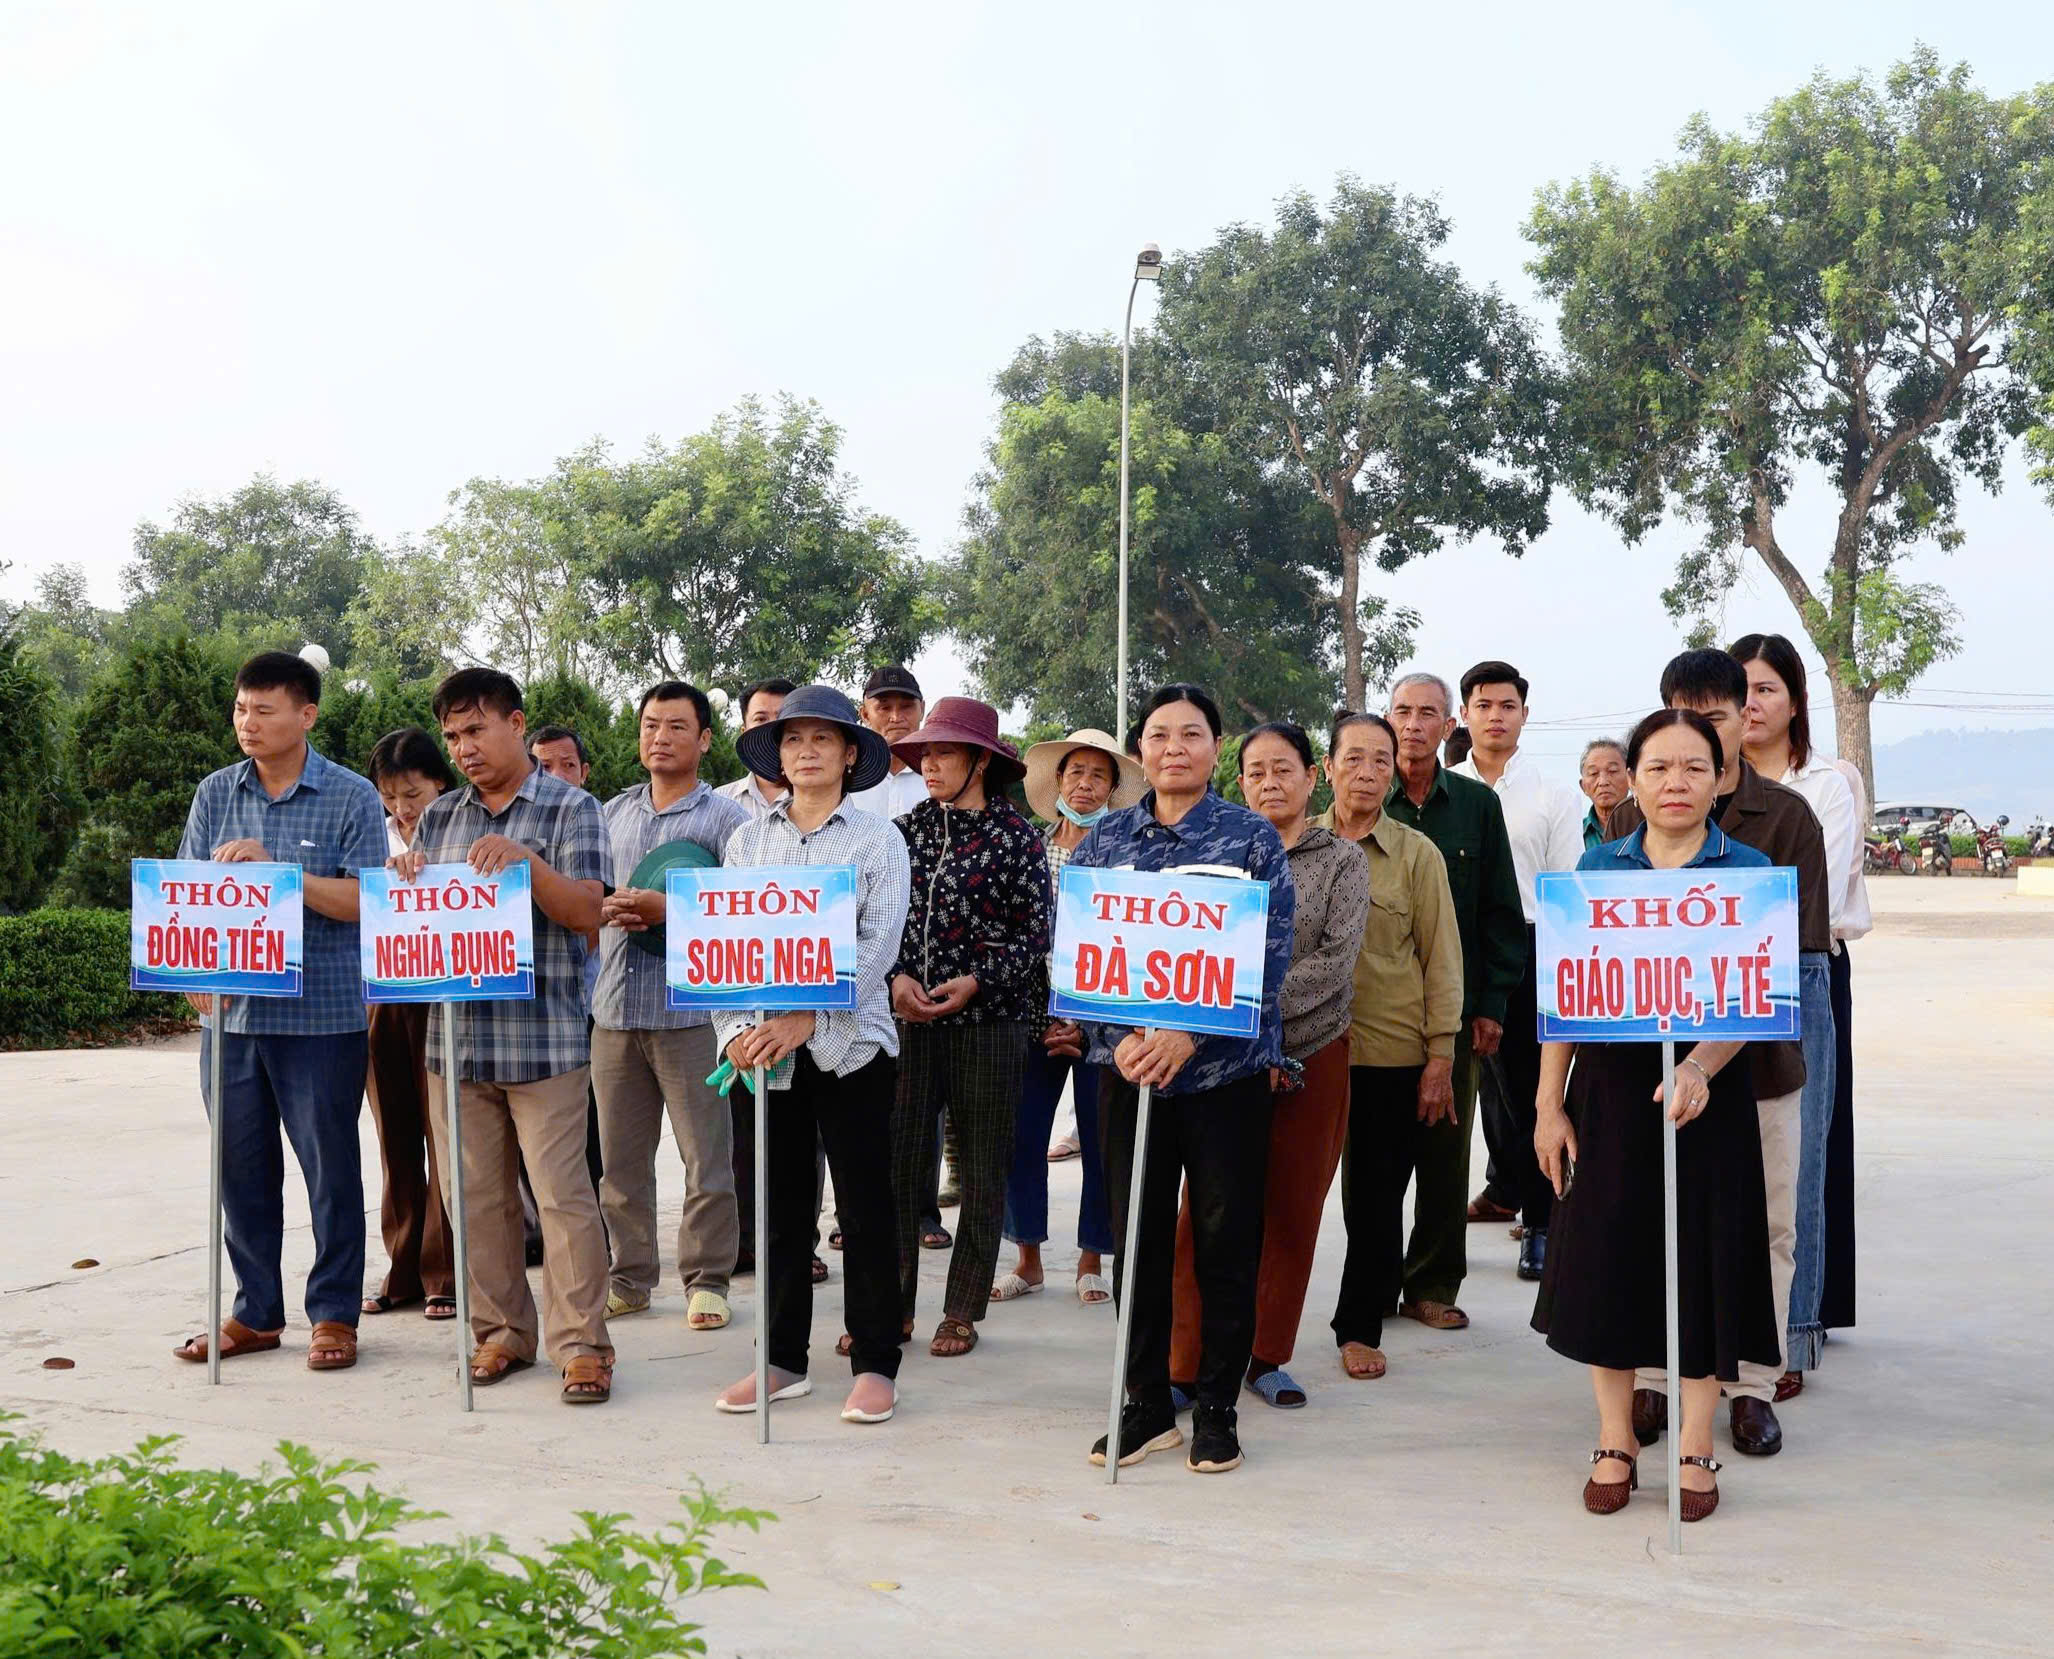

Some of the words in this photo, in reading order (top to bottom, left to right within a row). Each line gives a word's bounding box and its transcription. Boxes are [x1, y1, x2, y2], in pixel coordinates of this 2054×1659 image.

[162, 876, 271, 908] THÔN
[389, 878, 498, 913] THÔN
[698, 881, 821, 917] THÔN
[1093, 891, 1228, 931] THÔN
[1588, 883, 1742, 929] KHỐI
[147, 912, 219, 970] ĐỒNG
[226, 915, 285, 973] TIẾN
[375, 925, 446, 979] NGHĨA
[451, 930, 516, 986] ĐỤNG
[687, 937, 764, 985] SONG
[773, 936, 836, 985] NGA
[1075, 935, 1129, 996] ĐÀ
[1143, 947, 1235, 1007] SƠN
[1556, 945, 1625, 1018] GIÁO
[1634, 956, 1702, 1030] DỤC,
[1711, 956, 1729, 1016] Y
[1737, 935, 1774, 1016] TẾ
